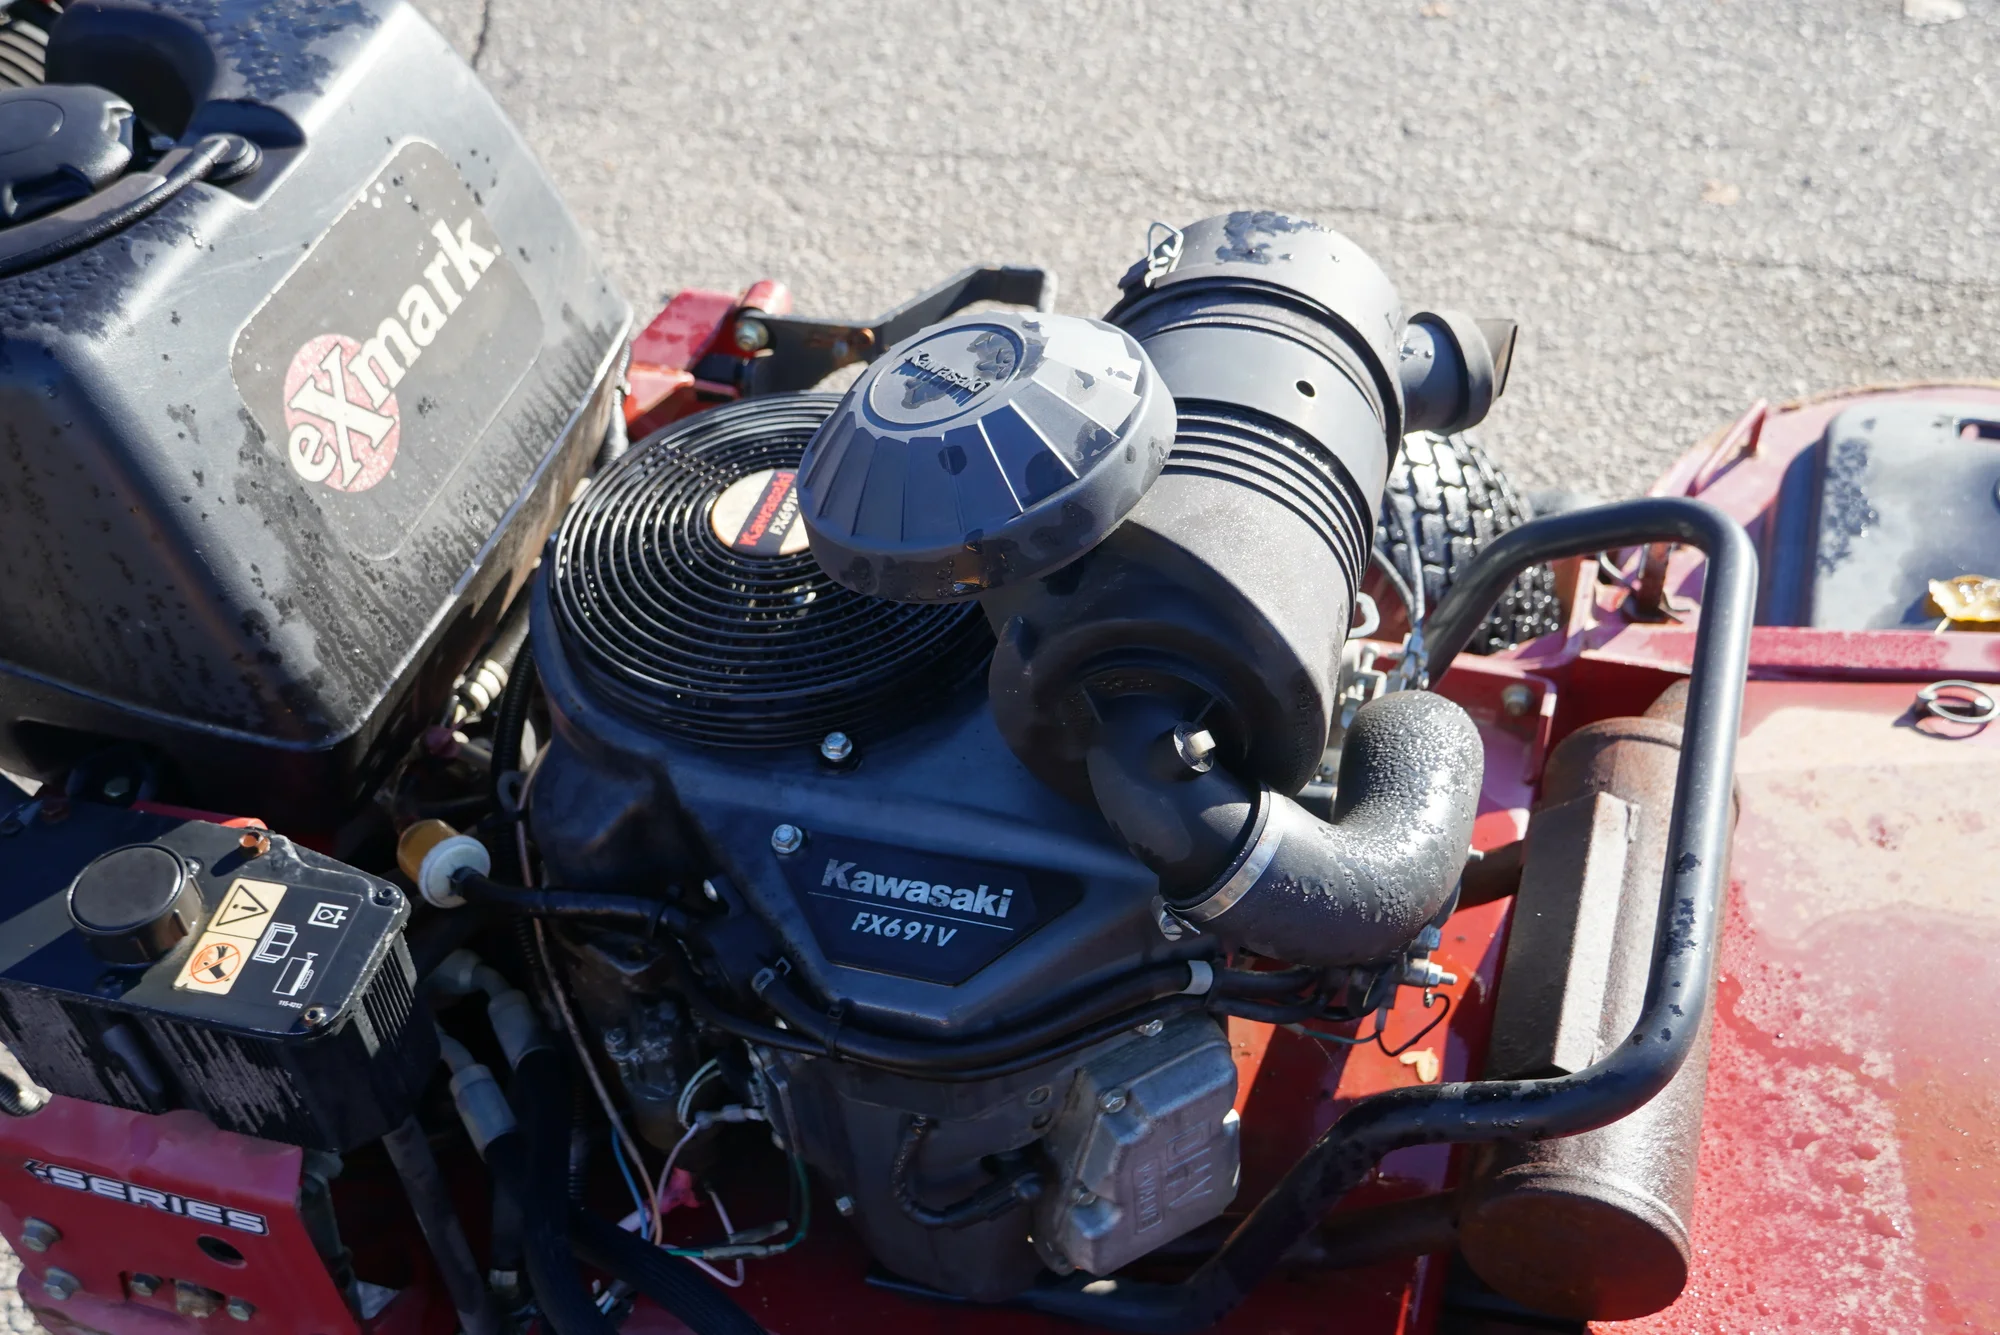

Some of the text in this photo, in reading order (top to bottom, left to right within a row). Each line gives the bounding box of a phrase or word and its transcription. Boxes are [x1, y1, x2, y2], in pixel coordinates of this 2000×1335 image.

[903, 349, 990, 394] Kawasaki
[739, 472, 796, 546] Kawasaki
[821, 858, 1014, 918] Kawasaki
[851, 911, 957, 947] FX691V
